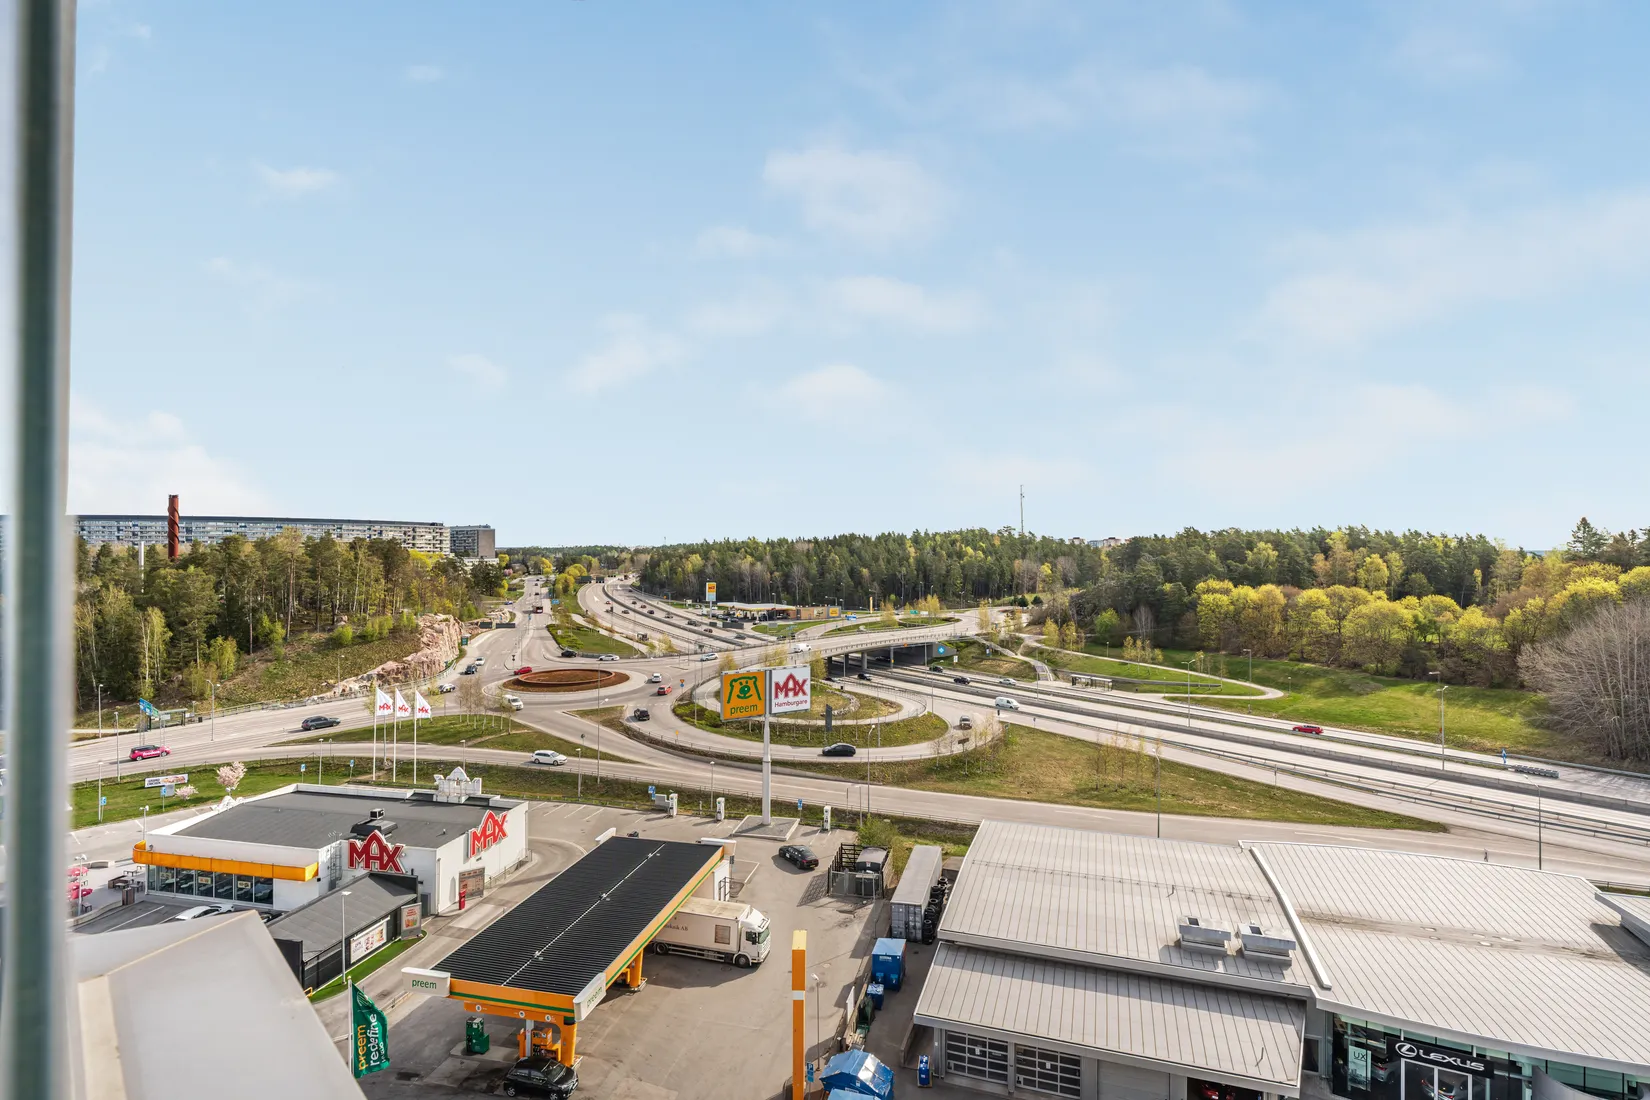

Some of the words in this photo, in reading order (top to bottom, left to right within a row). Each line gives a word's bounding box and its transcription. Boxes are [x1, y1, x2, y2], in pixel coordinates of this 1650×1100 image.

[774, 672, 808, 700] MAX
[379, 702, 391, 711] MAX
[730, 704, 758, 716] preem
[774, 699, 808, 708] Hamburgare
[469, 810, 508, 858] MAX
[348, 829, 406, 874] MAX
[411, 979, 437, 989] preem
[357, 1024, 369, 1071] preem
[367, 1013, 380, 1067] redefine
[1353, 1051, 1367, 1061] UX
[1418, 1049, 1485, 1071] LEXUS
